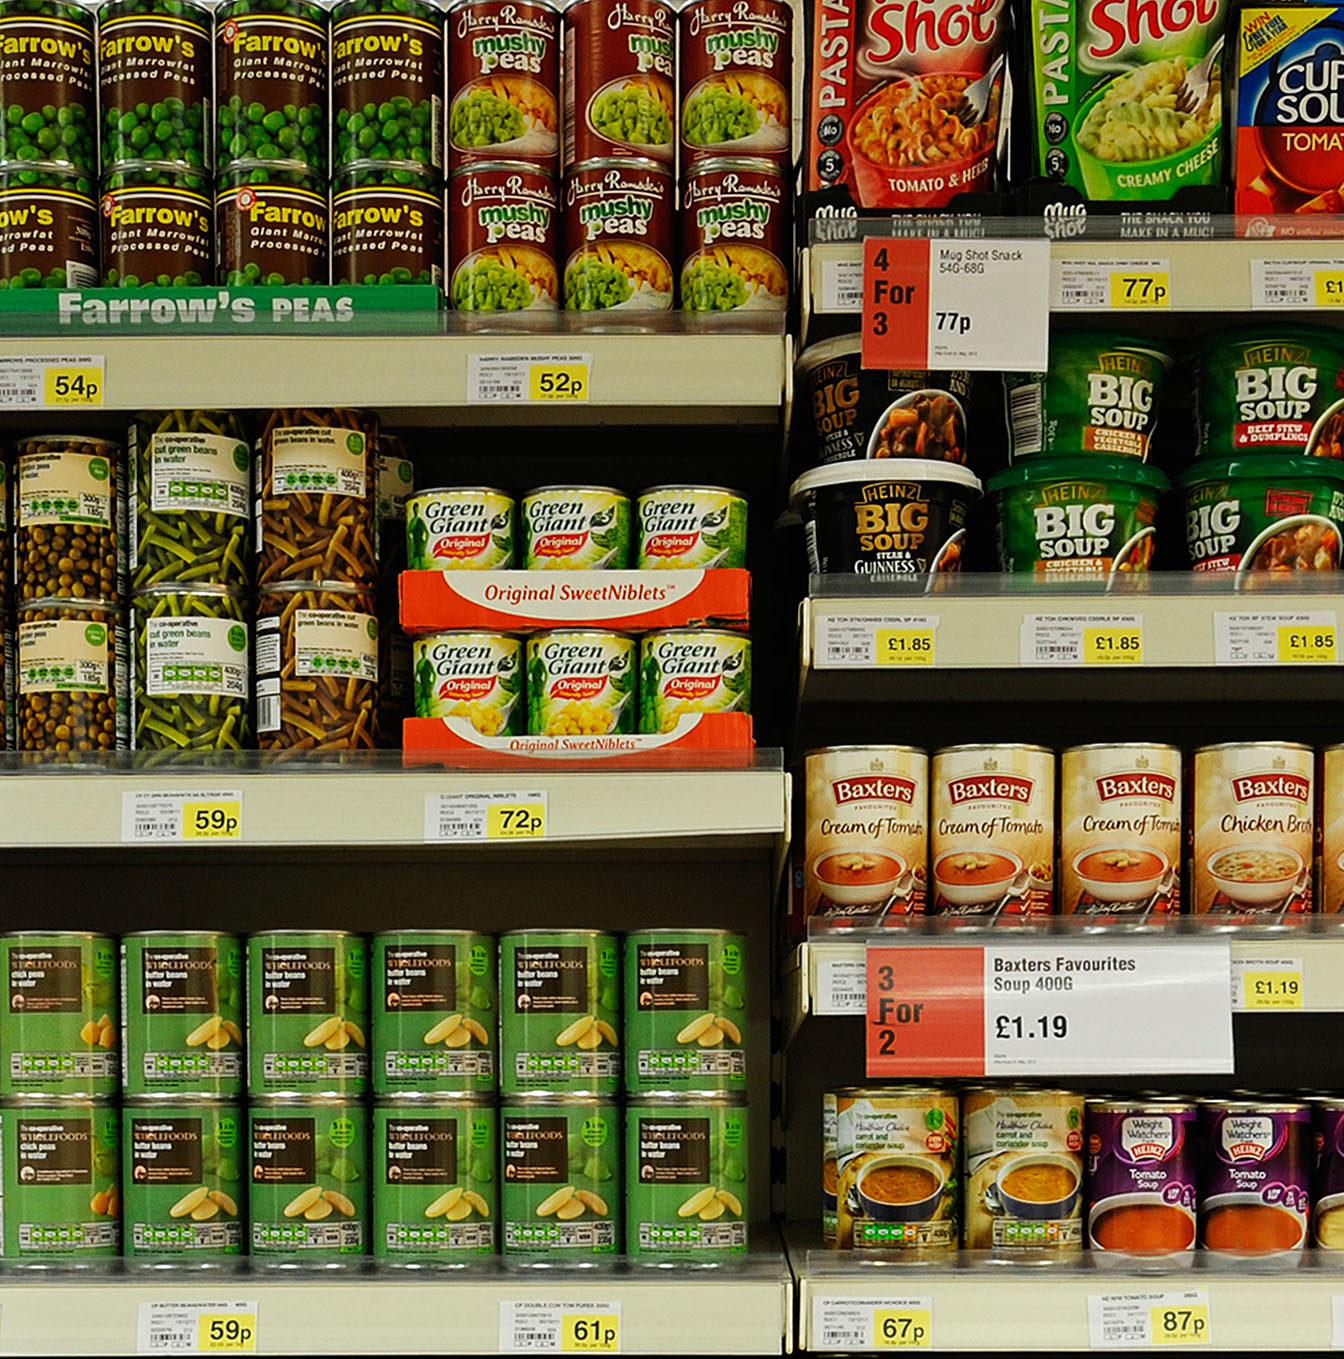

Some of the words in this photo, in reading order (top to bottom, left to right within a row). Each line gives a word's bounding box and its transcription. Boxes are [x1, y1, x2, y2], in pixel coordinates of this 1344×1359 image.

[474, 35, 546, 59] mushy
[481, 51, 541, 74] peas
[1117, 169, 1171, 188] CREAMY
[1177, 144, 1219, 180] CHEESE
[873, 249, 889, 271] 4
[940, 250, 965, 263] Mug
[968, 250, 991, 261] Shot
[994, 250, 1023, 261] Snack
[940, 263, 985, 274] 54G-68G
[873, 281, 915, 305] For
[59, 292, 255, 324] Farrow's
[272, 297, 353, 324] PEAS
[873, 315, 888, 336] 3
[936, 312, 971, 335] 77p
[55, 374, 97, 397] 54p
[540, 374, 582, 394] 52p
[425, 501, 485, 519] Green
[430, 516, 488, 535] Giant
[440, 536, 486, 550] Original
[485, 584, 555, 604] Original
[1290, 634, 1334, 649] £1.85
[195, 809, 238, 832] 59p
[938, 818, 980, 836] Cream
[982, 816, 1000, 840] of
[1000, 818, 1044, 836] Tomato
[994, 958, 1050, 973] Baxters
[1055, 957, 1135, 973] Favourites
[878, 965, 894, 991] 3
[994, 976, 1029, 994] Soup
[1036, 976, 1073, 992] 400G
[876, 997, 923, 1025] For
[995, 1016, 1068, 1040] £1.19
[878, 1030, 895, 1055] 2
[1229, 1169, 1266, 1180] Tomato
[1237, 1179, 1257, 1190] Soup
[573, 1319, 616, 1343] 61p
